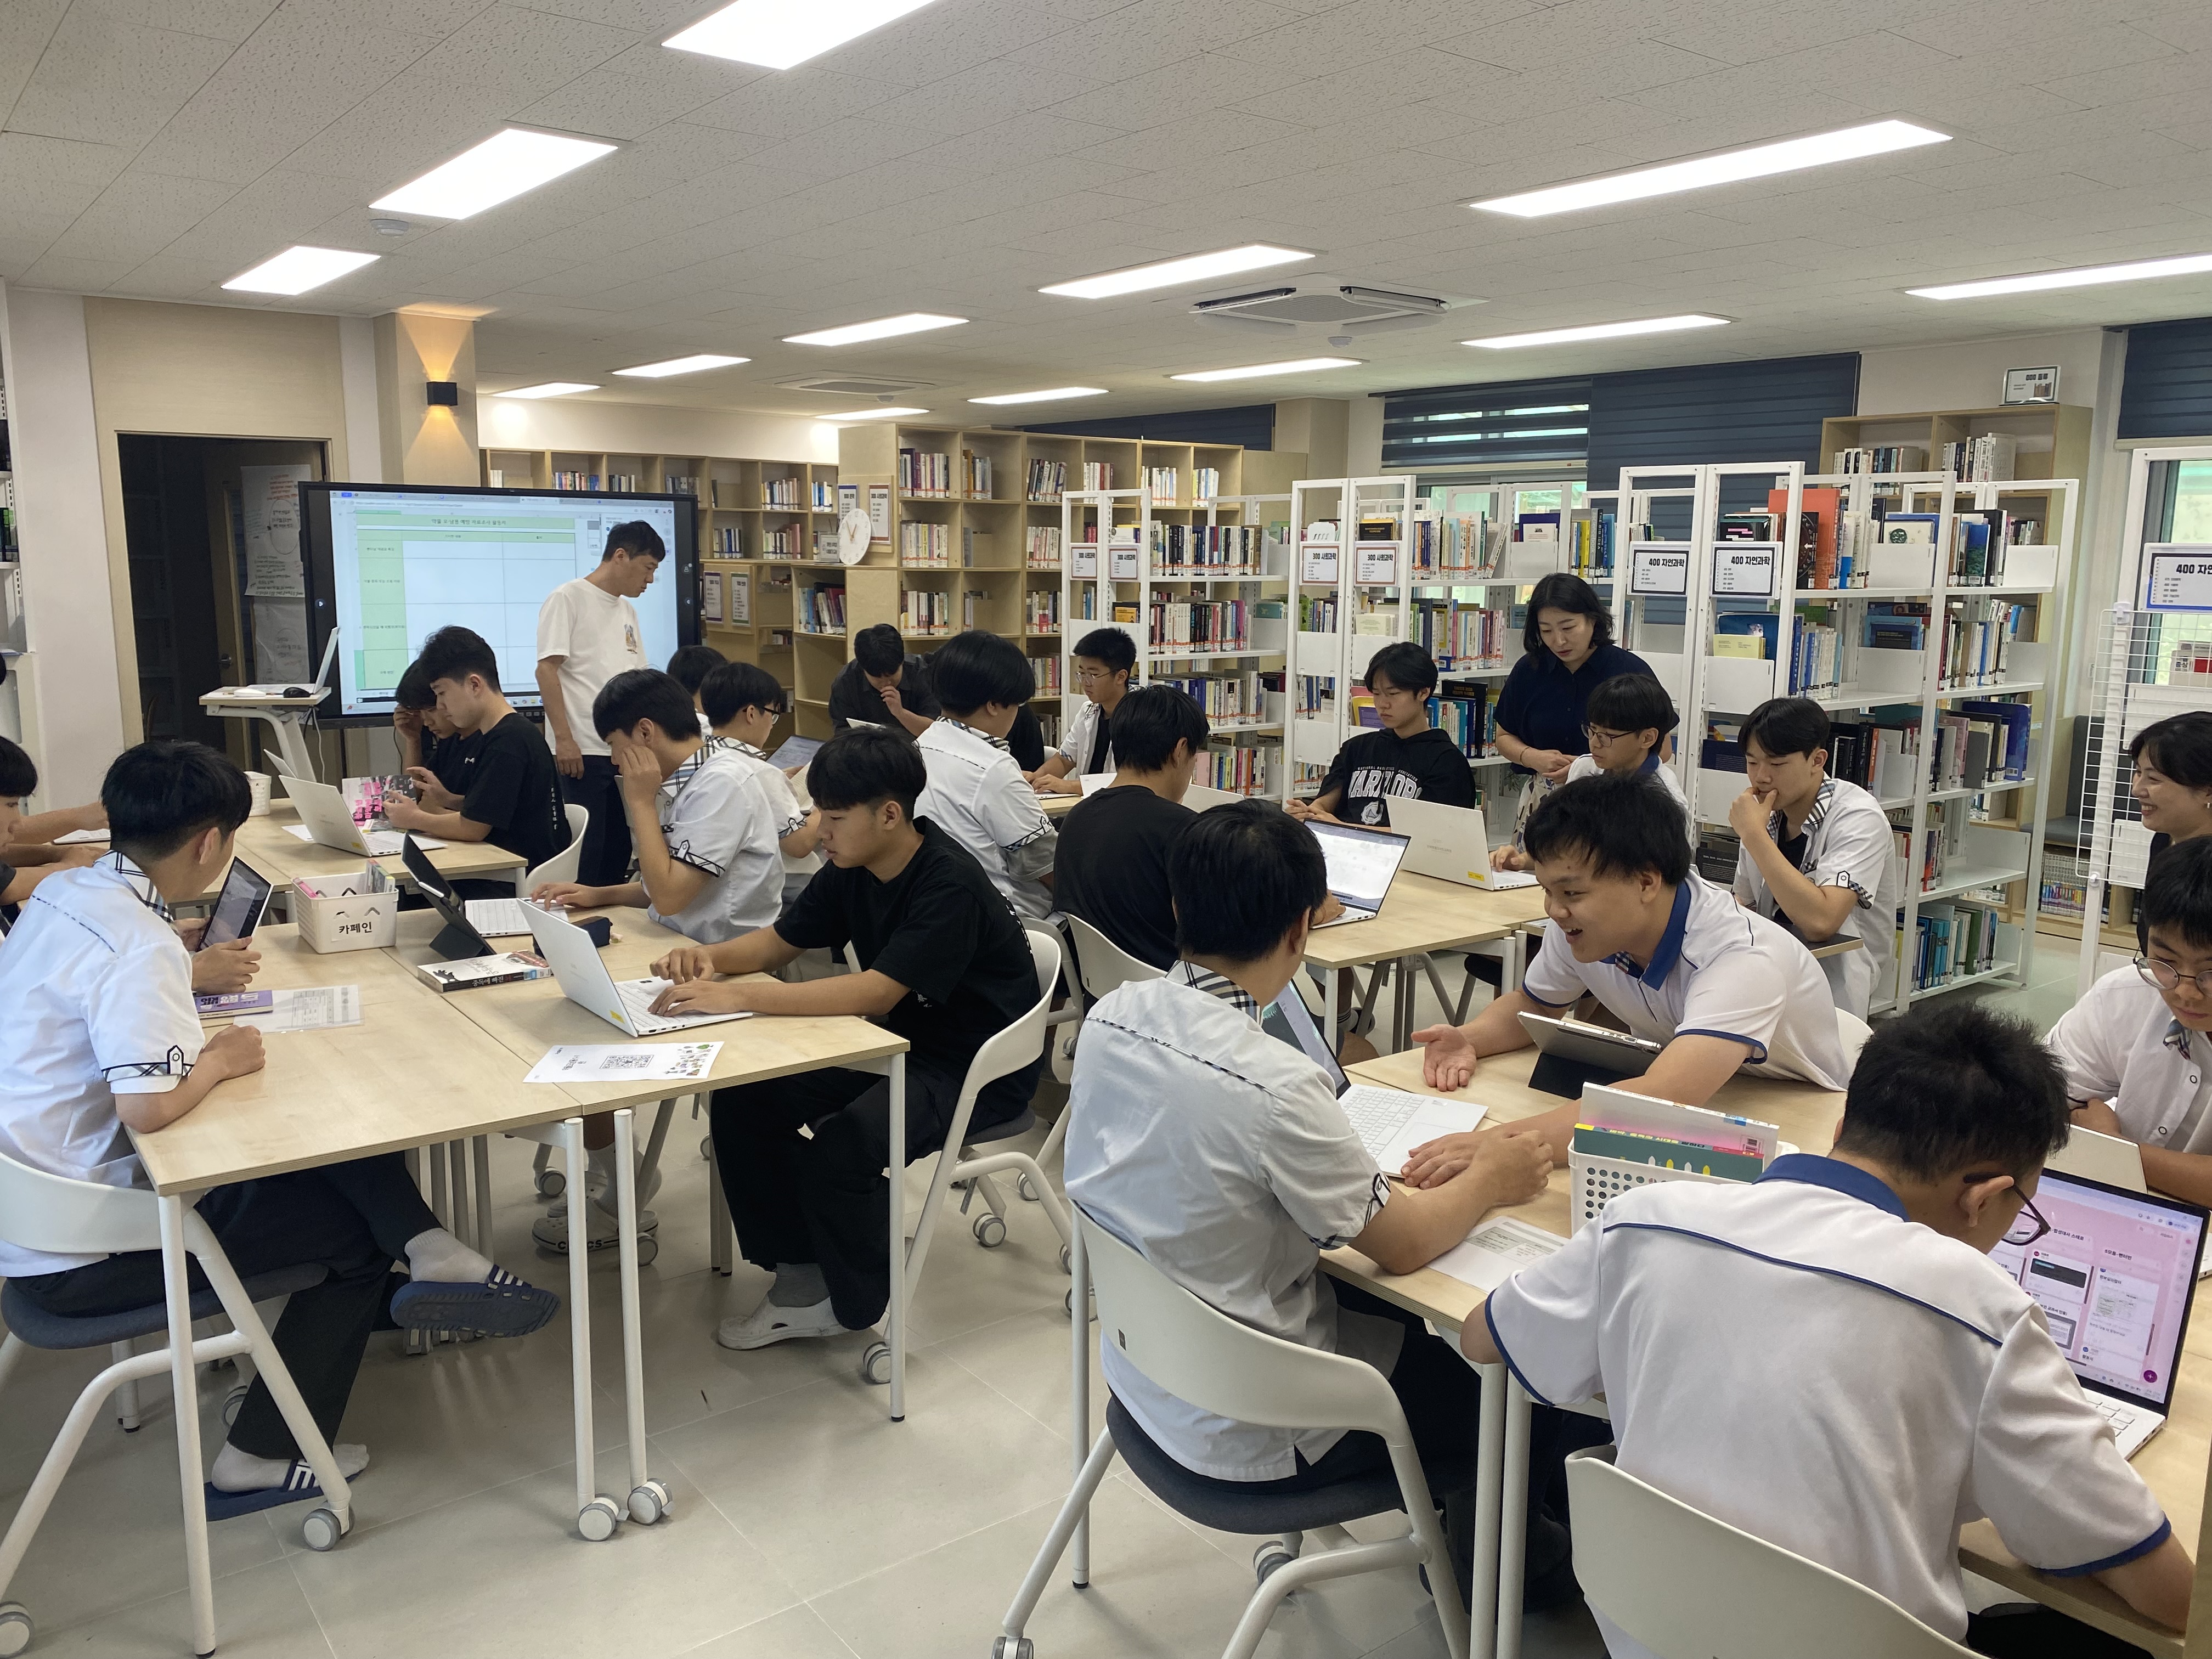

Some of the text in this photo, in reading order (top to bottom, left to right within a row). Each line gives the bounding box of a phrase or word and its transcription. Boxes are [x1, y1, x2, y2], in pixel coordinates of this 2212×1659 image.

[1649, 558, 1685, 567] 400 자연과학
[1731, 556, 1770, 566] 400 자연과학
[2176, 564, 2195, 574] 400
[338, 922, 373, 934] 카페인
[472, 977, 490, 987] 중독에
[492, 975, 504, 984] 빠진
